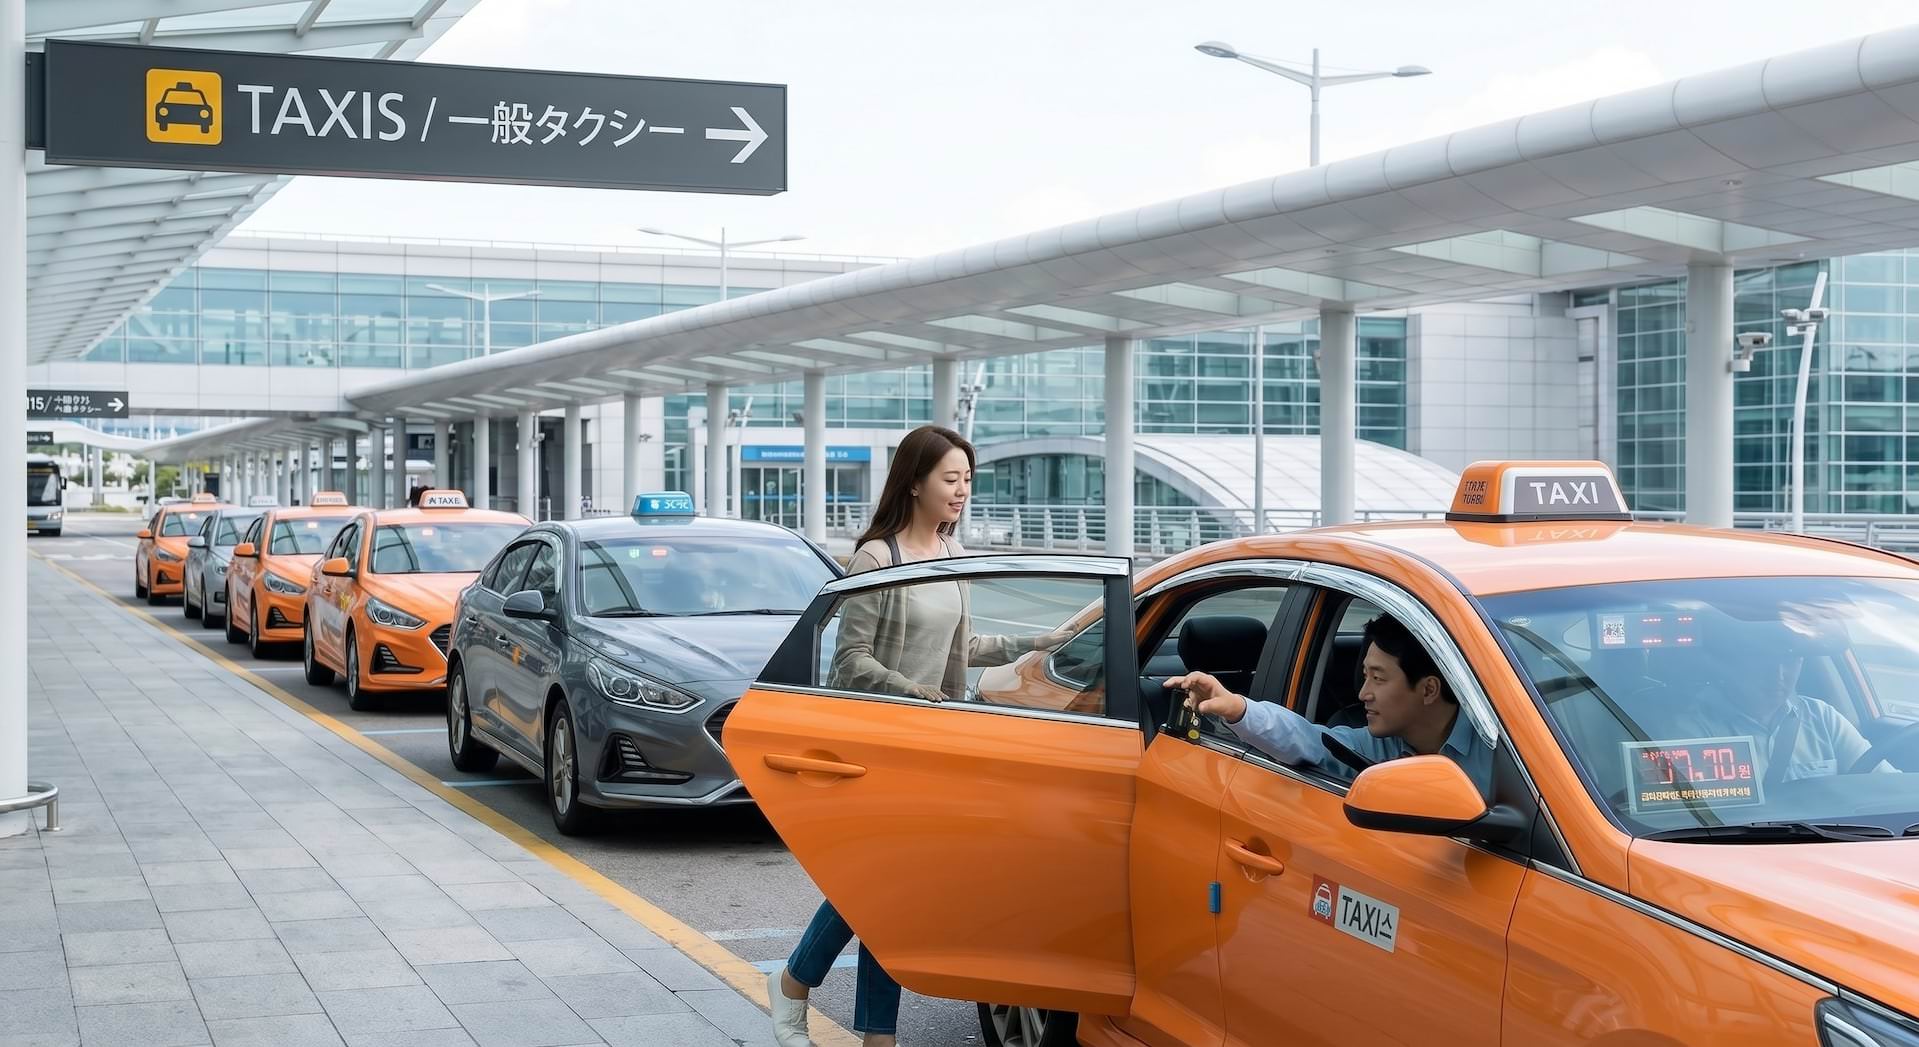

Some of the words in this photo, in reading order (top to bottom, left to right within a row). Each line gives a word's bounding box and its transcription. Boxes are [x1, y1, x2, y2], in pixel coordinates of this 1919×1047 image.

[237, 84, 406, 142] TAXIS
[448, 101, 685, 148] 一般タクシー
[1529, 482, 1598, 504] TAXI
